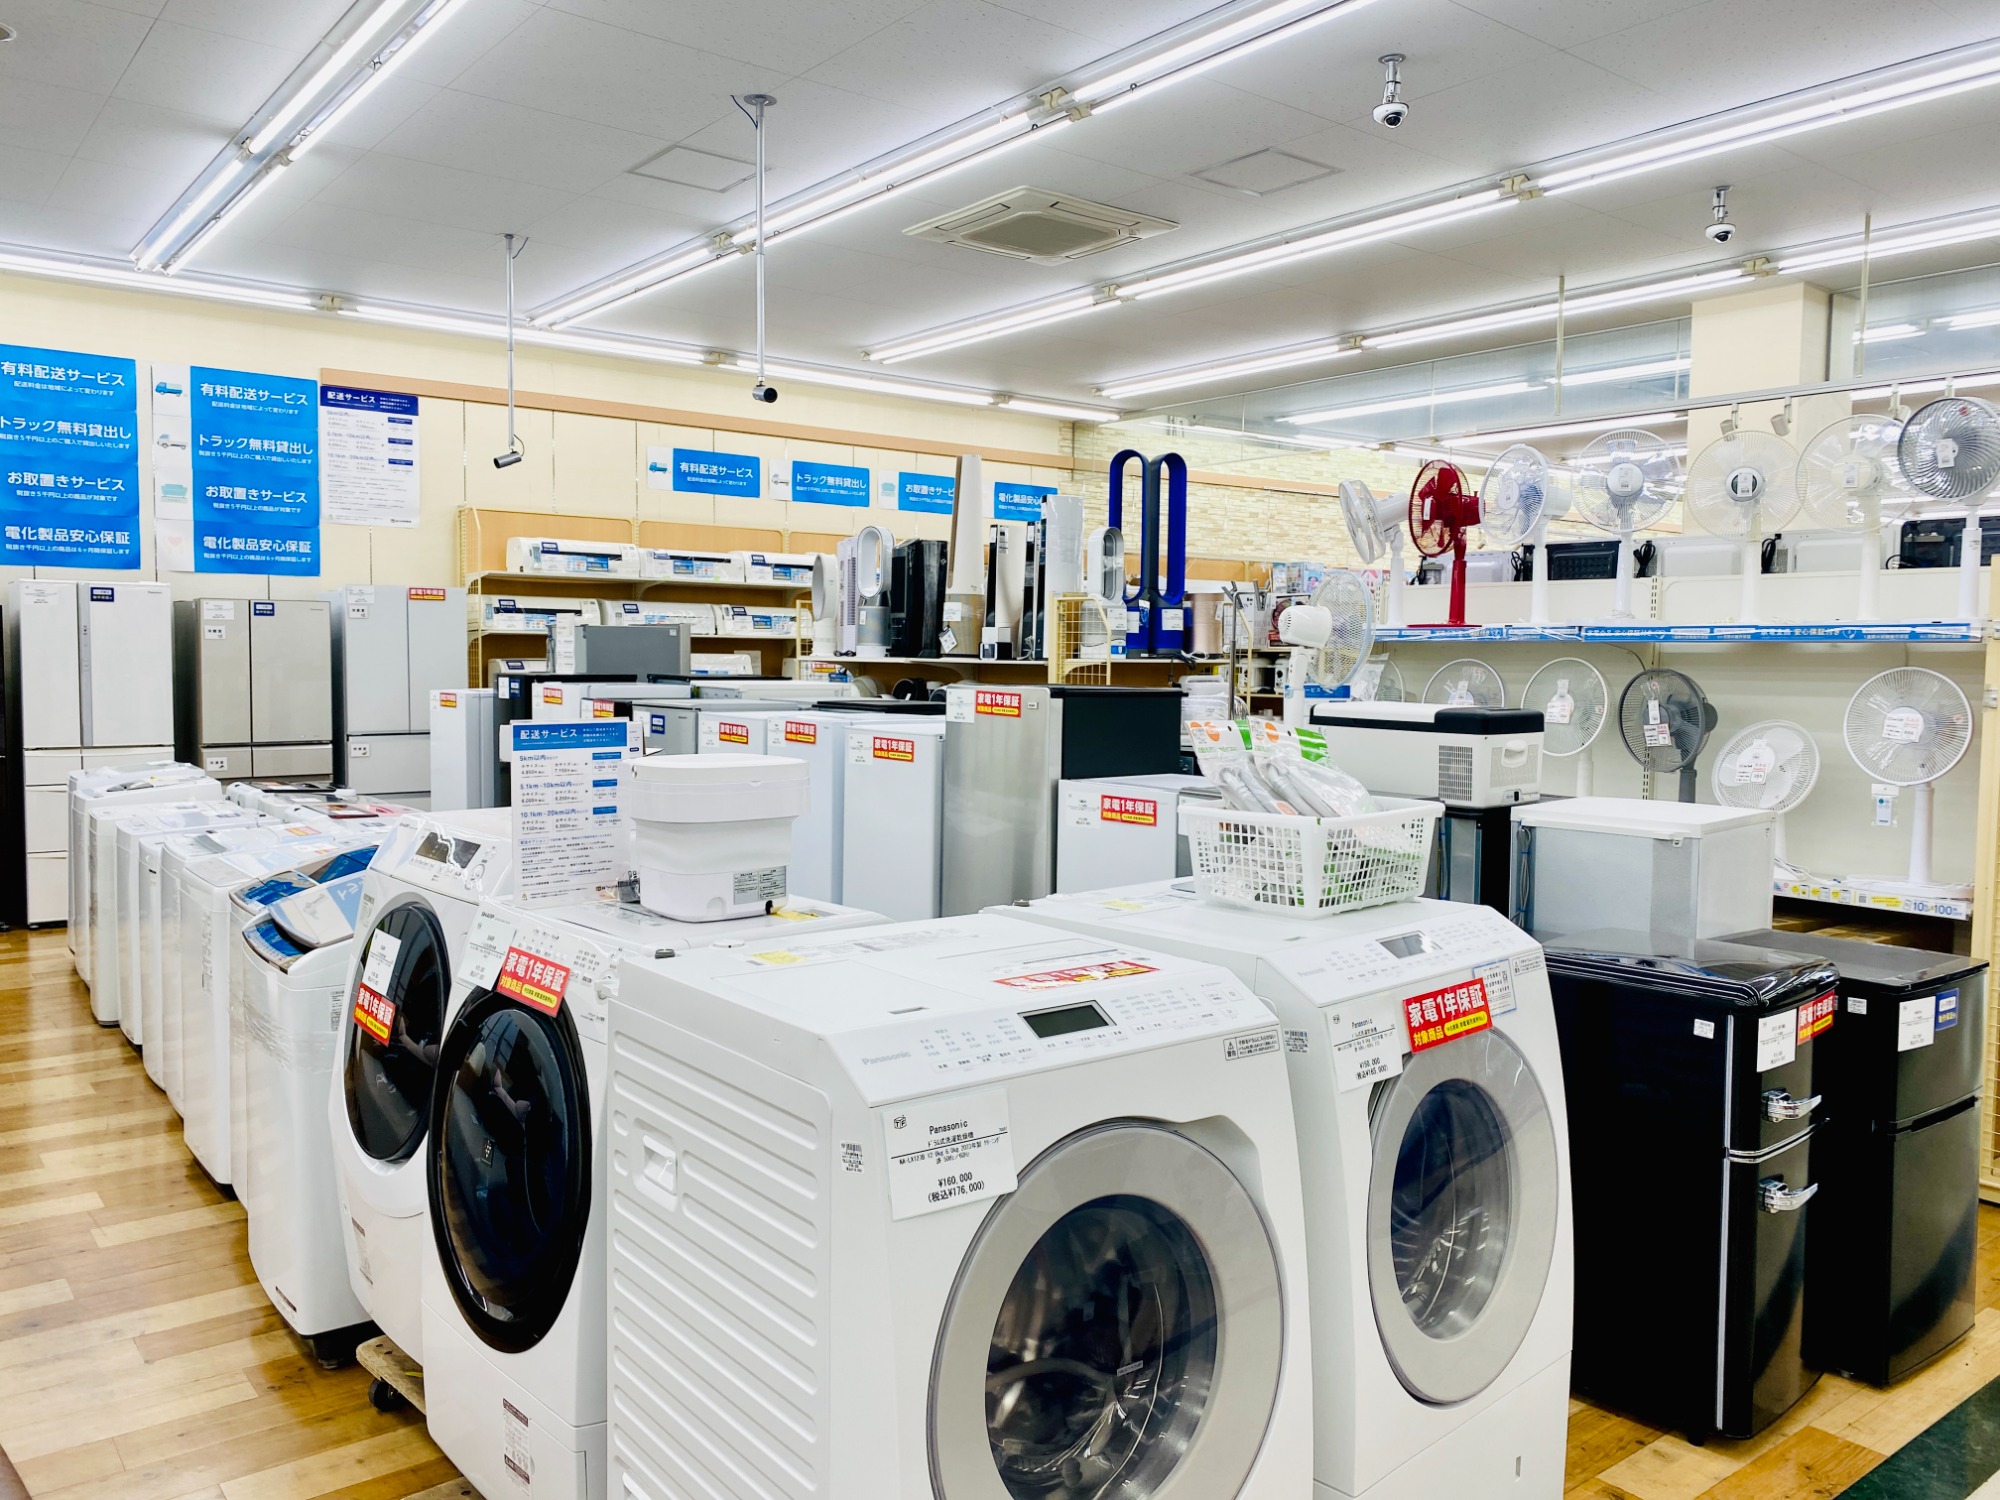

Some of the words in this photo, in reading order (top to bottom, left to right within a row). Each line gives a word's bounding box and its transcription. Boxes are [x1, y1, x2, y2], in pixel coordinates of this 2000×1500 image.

[1, 361, 125, 386] 有料配送サービス
[13, 380, 114, 396] 配送料金は地域によって変わります
[200, 383, 308, 405] 有料配送サービス
[327, 391, 375, 403] 配送サービス
[0, 415, 131, 439] トラック無料貸出し
[200, 434, 313, 454] トラック無料貸出し
[680, 462, 753, 479] 有料配送サービス
[8, 471, 125, 491] お取置きサービス
[797, 473, 866, 488] トラック無料貸出し
[205, 486, 308, 503] お取置きサービス
[5, 525, 130, 544] 電化製品安心保証
[203, 536, 311, 553] 電化製品安心保証
[977, 693, 1019, 707] 家電1年保証
[520, 729, 577, 739] 配送サービス
[874, 739, 913, 752] 家電1年保証
[1103, 798, 1154, 814] 家電1年保証
[505, 951, 566, 992] 家電1年保証
[358, 988, 393, 1025] 家電1年保証
[1408, 984, 1484, 1027] 家電1年保証
[1414, 1026, 1444, 1046] 対象商品
[861, 1051, 911, 1066] Panasonic
[929, 1120, 968, 1135] Panasonic
[938, 1172, 973, 1187] ¥160,000
[928, 1181, 985, 1203] (税込¥176,000)
